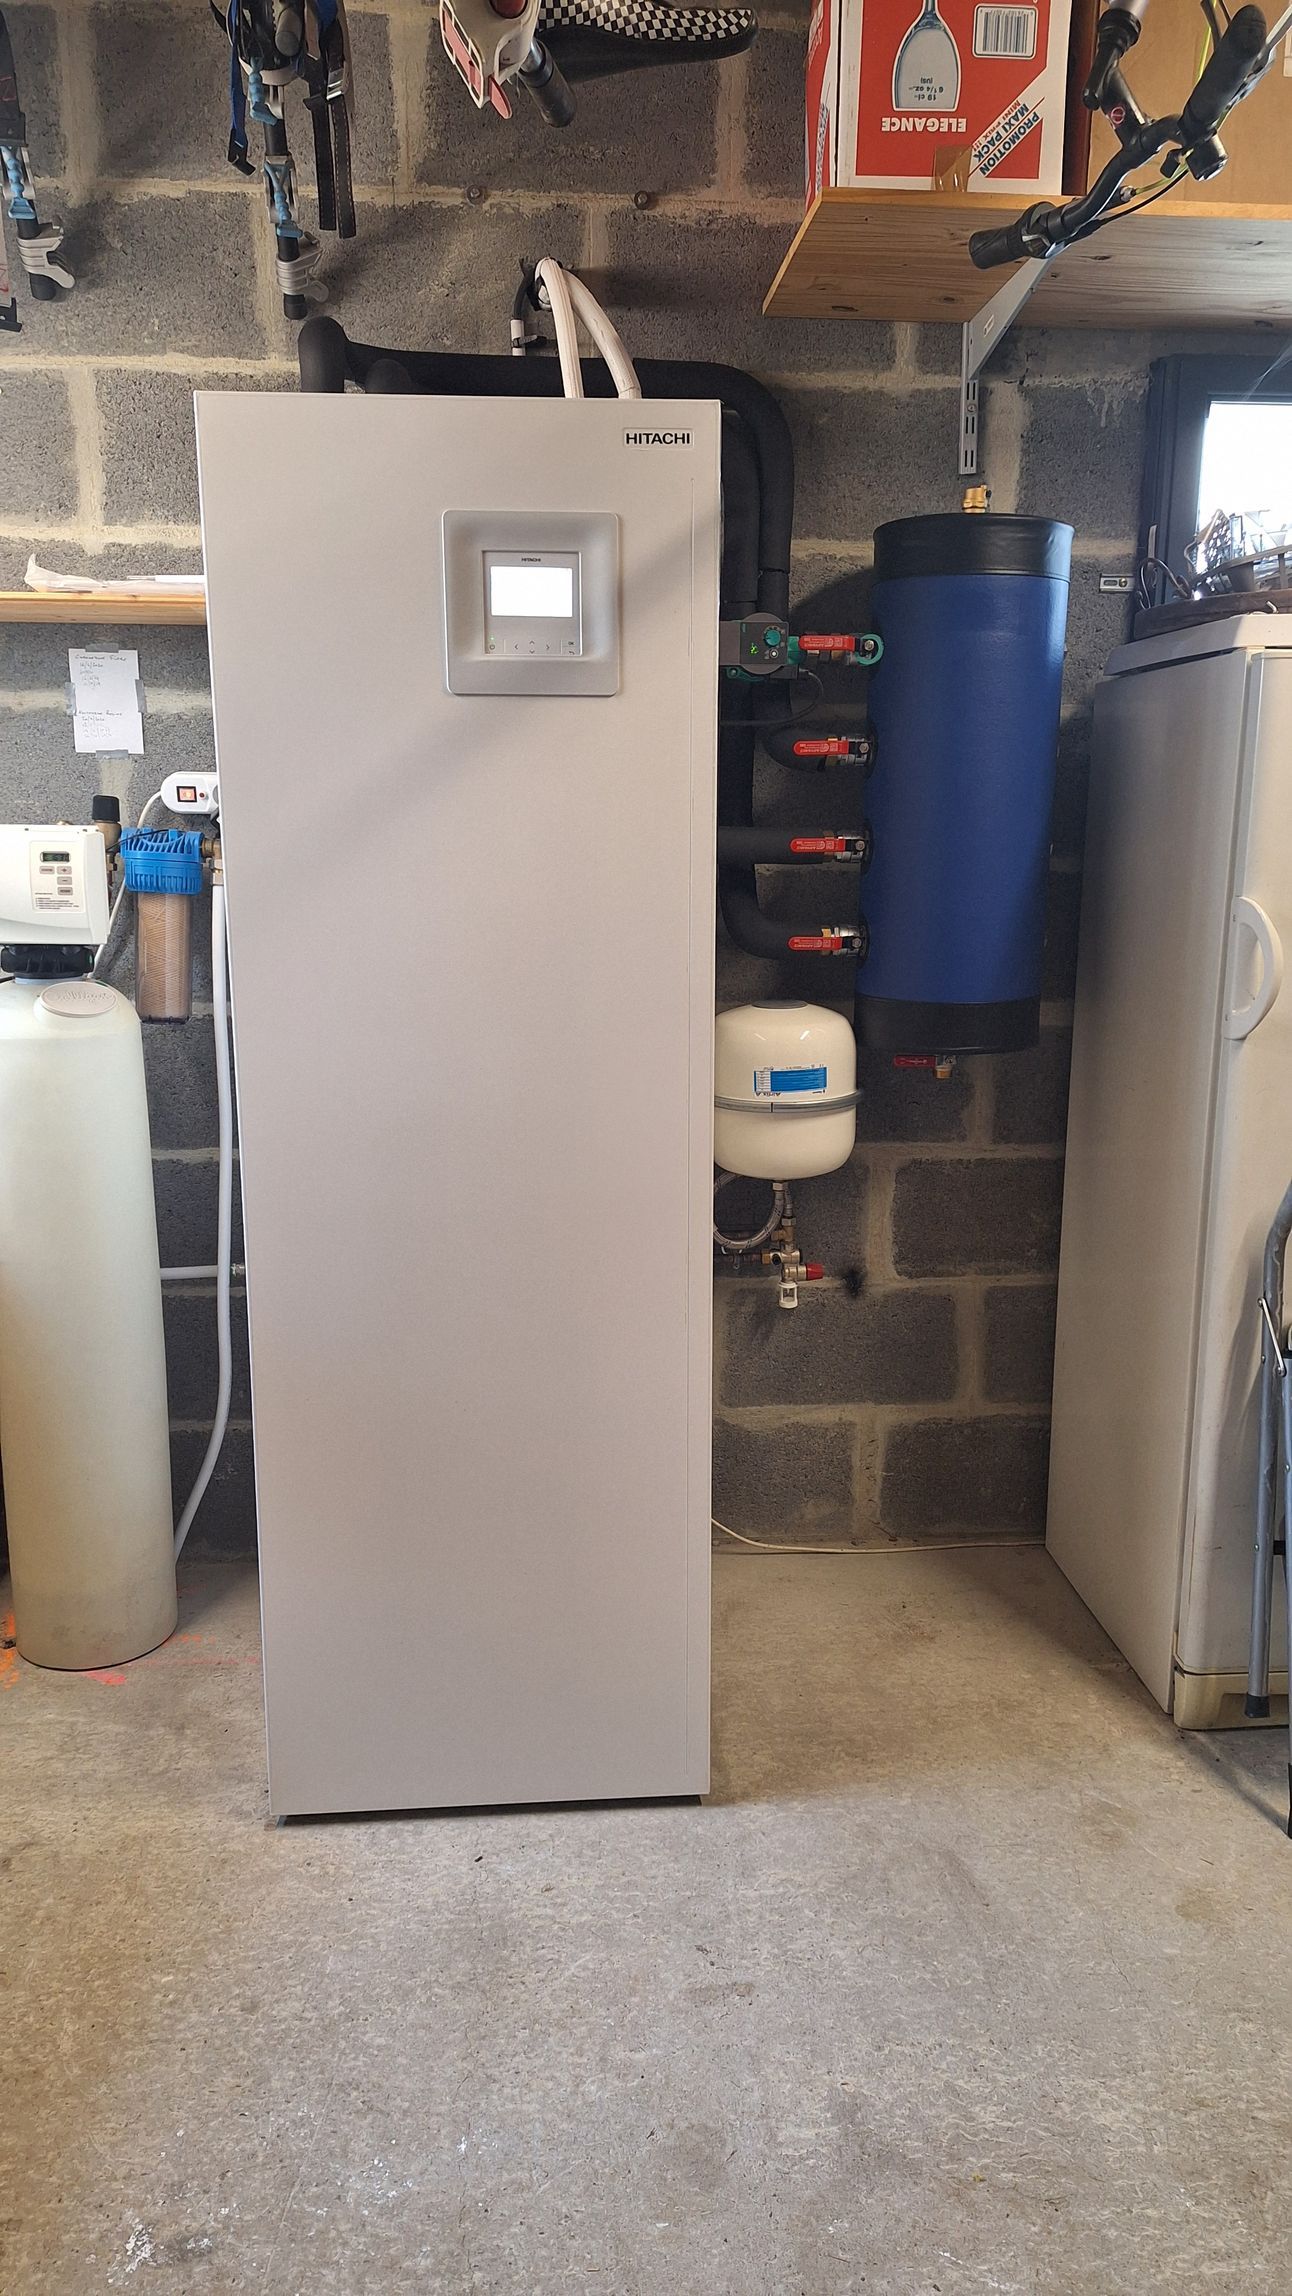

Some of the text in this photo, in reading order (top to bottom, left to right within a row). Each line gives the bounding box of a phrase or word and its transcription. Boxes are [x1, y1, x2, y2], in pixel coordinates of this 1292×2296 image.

[881, 117, 967, 133] ELEGANCE
[972, 103, 1030, 163] MAXI PACK
[979, 111, 1040, 176] PROMOTION
[625, 432, 691, 445] HITACHI
